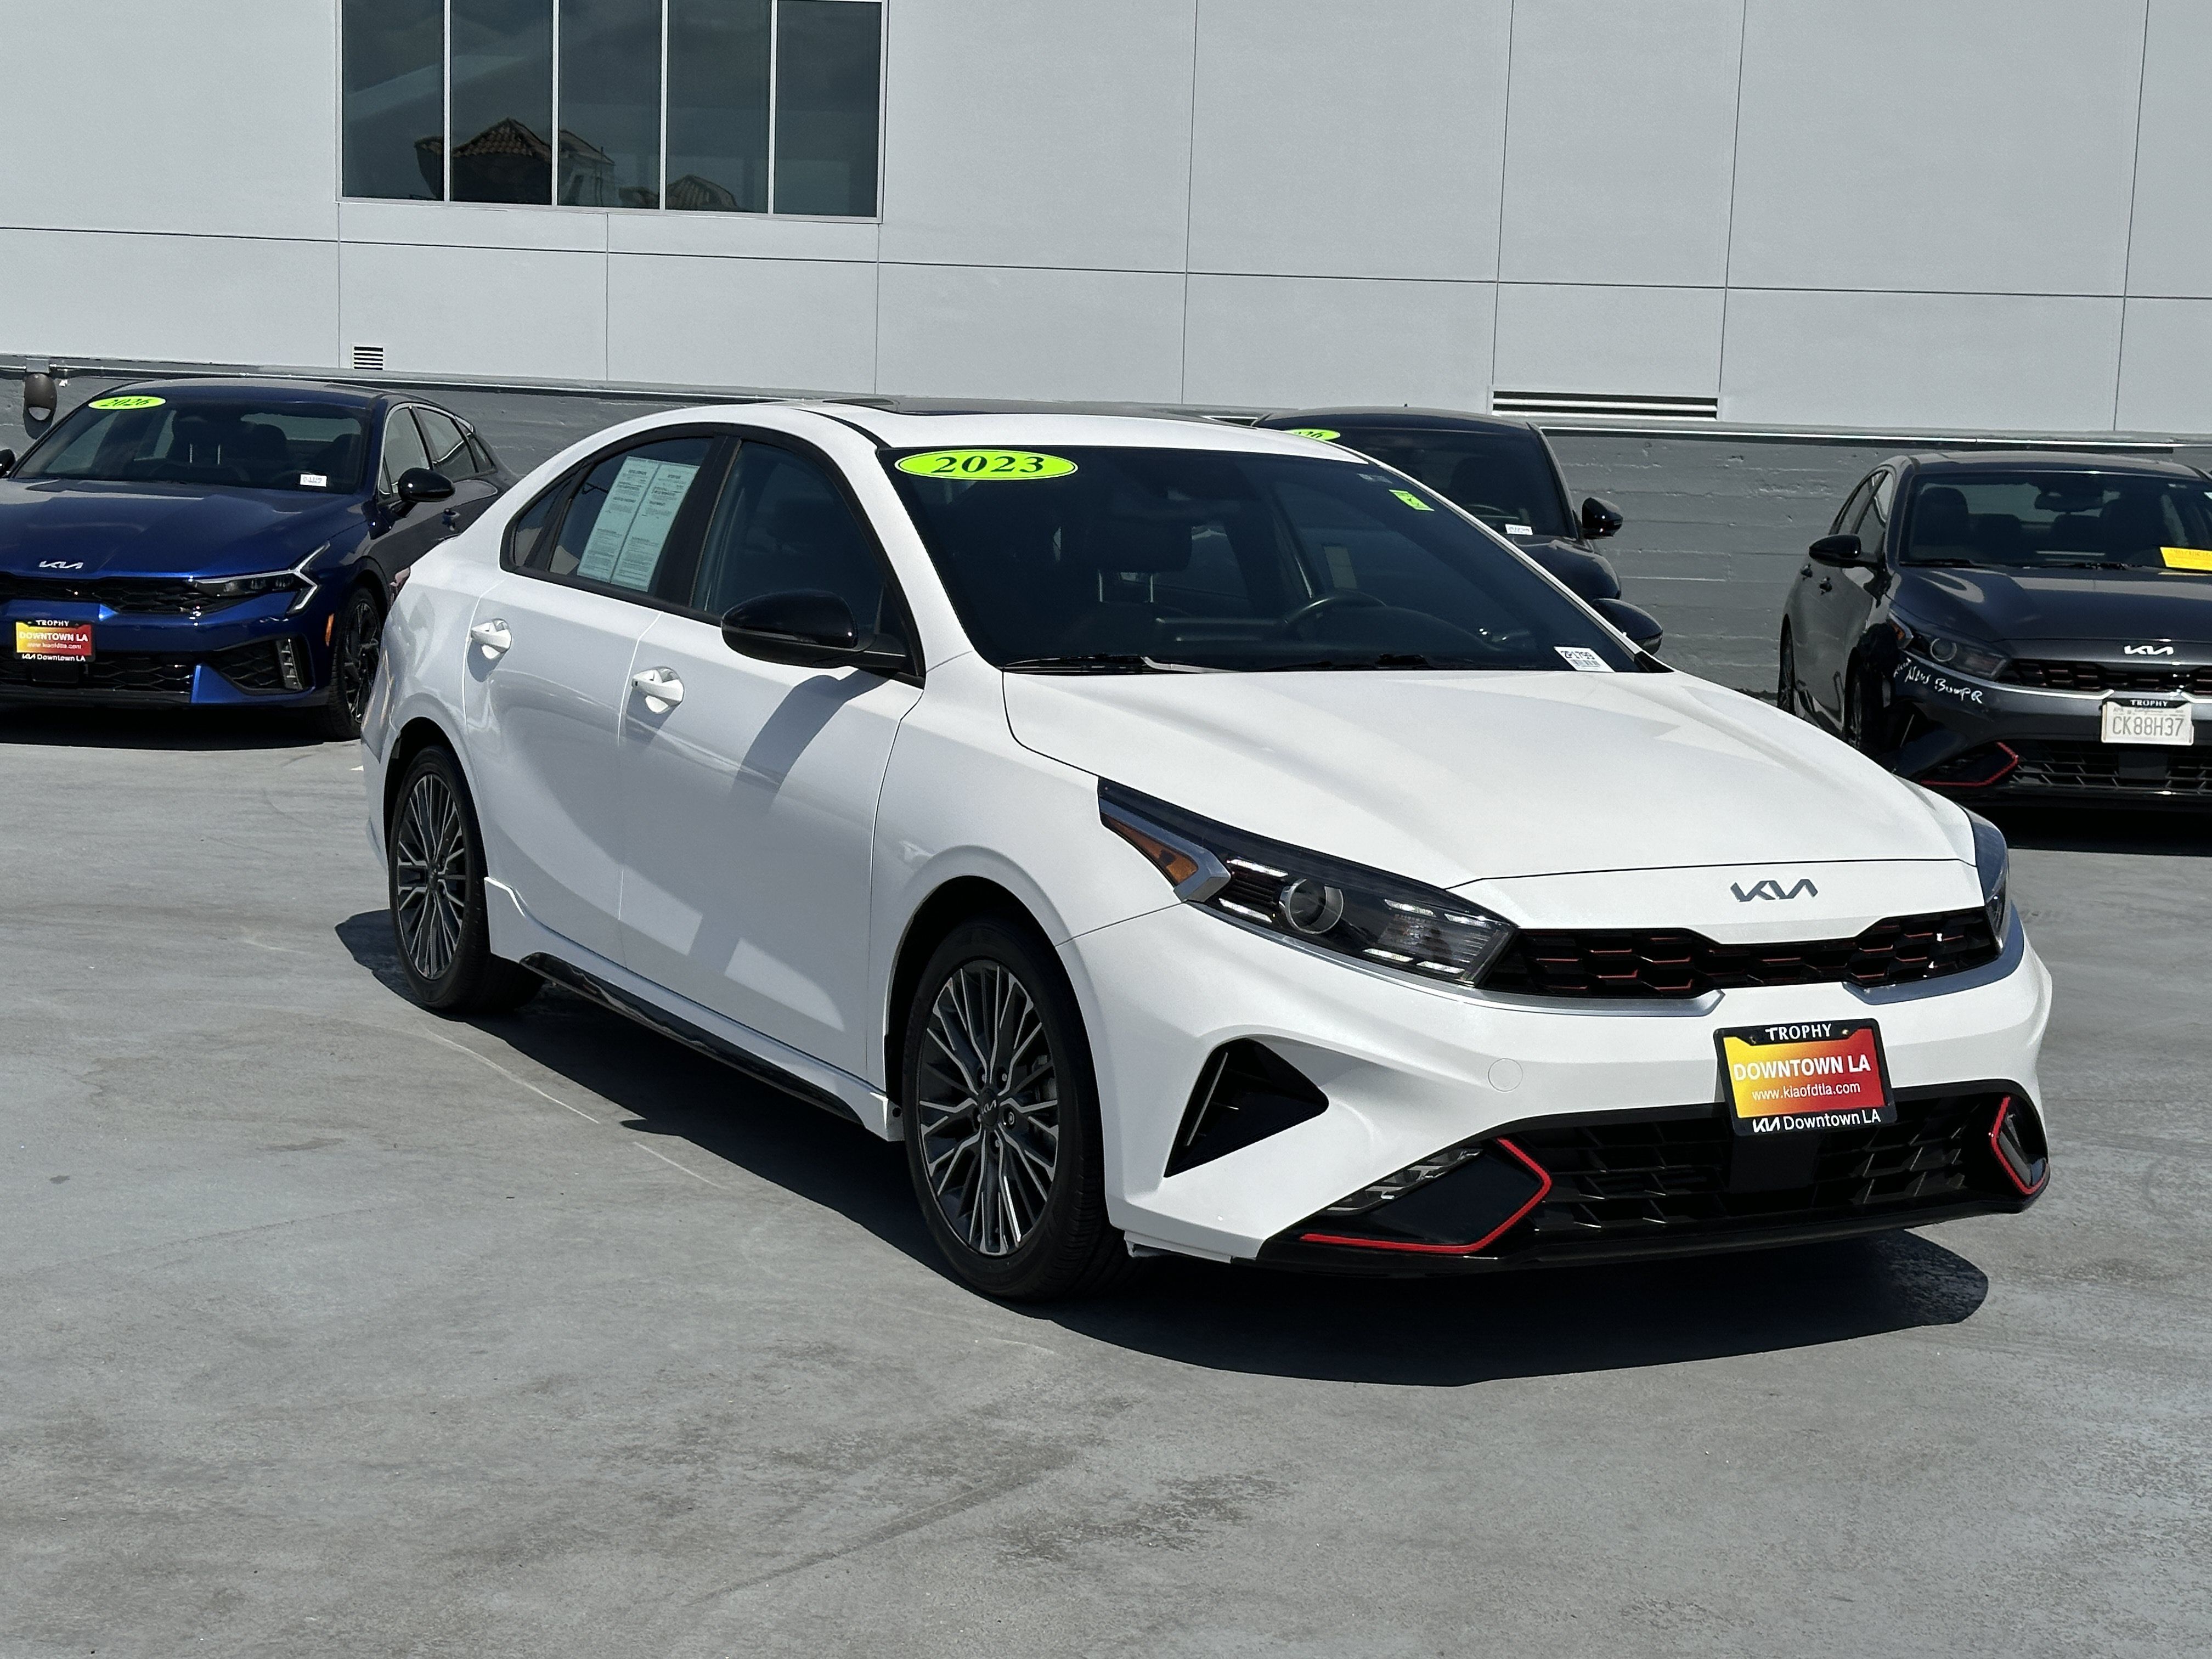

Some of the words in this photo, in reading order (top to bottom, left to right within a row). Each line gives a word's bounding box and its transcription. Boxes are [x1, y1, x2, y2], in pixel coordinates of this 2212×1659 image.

[930, 456, 1045, 473] 2023
[39, 561, 83, 569] KIA
[19, 631, 74, 641] DOWNTOWN
[76, 633, 88, 642] LA
[2124, 645, 2174, 656] KIA
[2113, 716, 2184, 736] CK88H37
[1730, 879, 1818, 902] KIA
[1765, 1023, 1832, 1041] TROPHY
[1733, 1056, 1844, 1081] DOWNTOWN
[1848, 1054, 1871, 1073] LA
[1752, 1082, 1861, 1101] www.kiaofdtla.com
[1752, 1117, 1780, 1133] KIA
[1783, 1111, 1860, 1131] Downtown
[1861, 1108, 1881, 1125] LA
